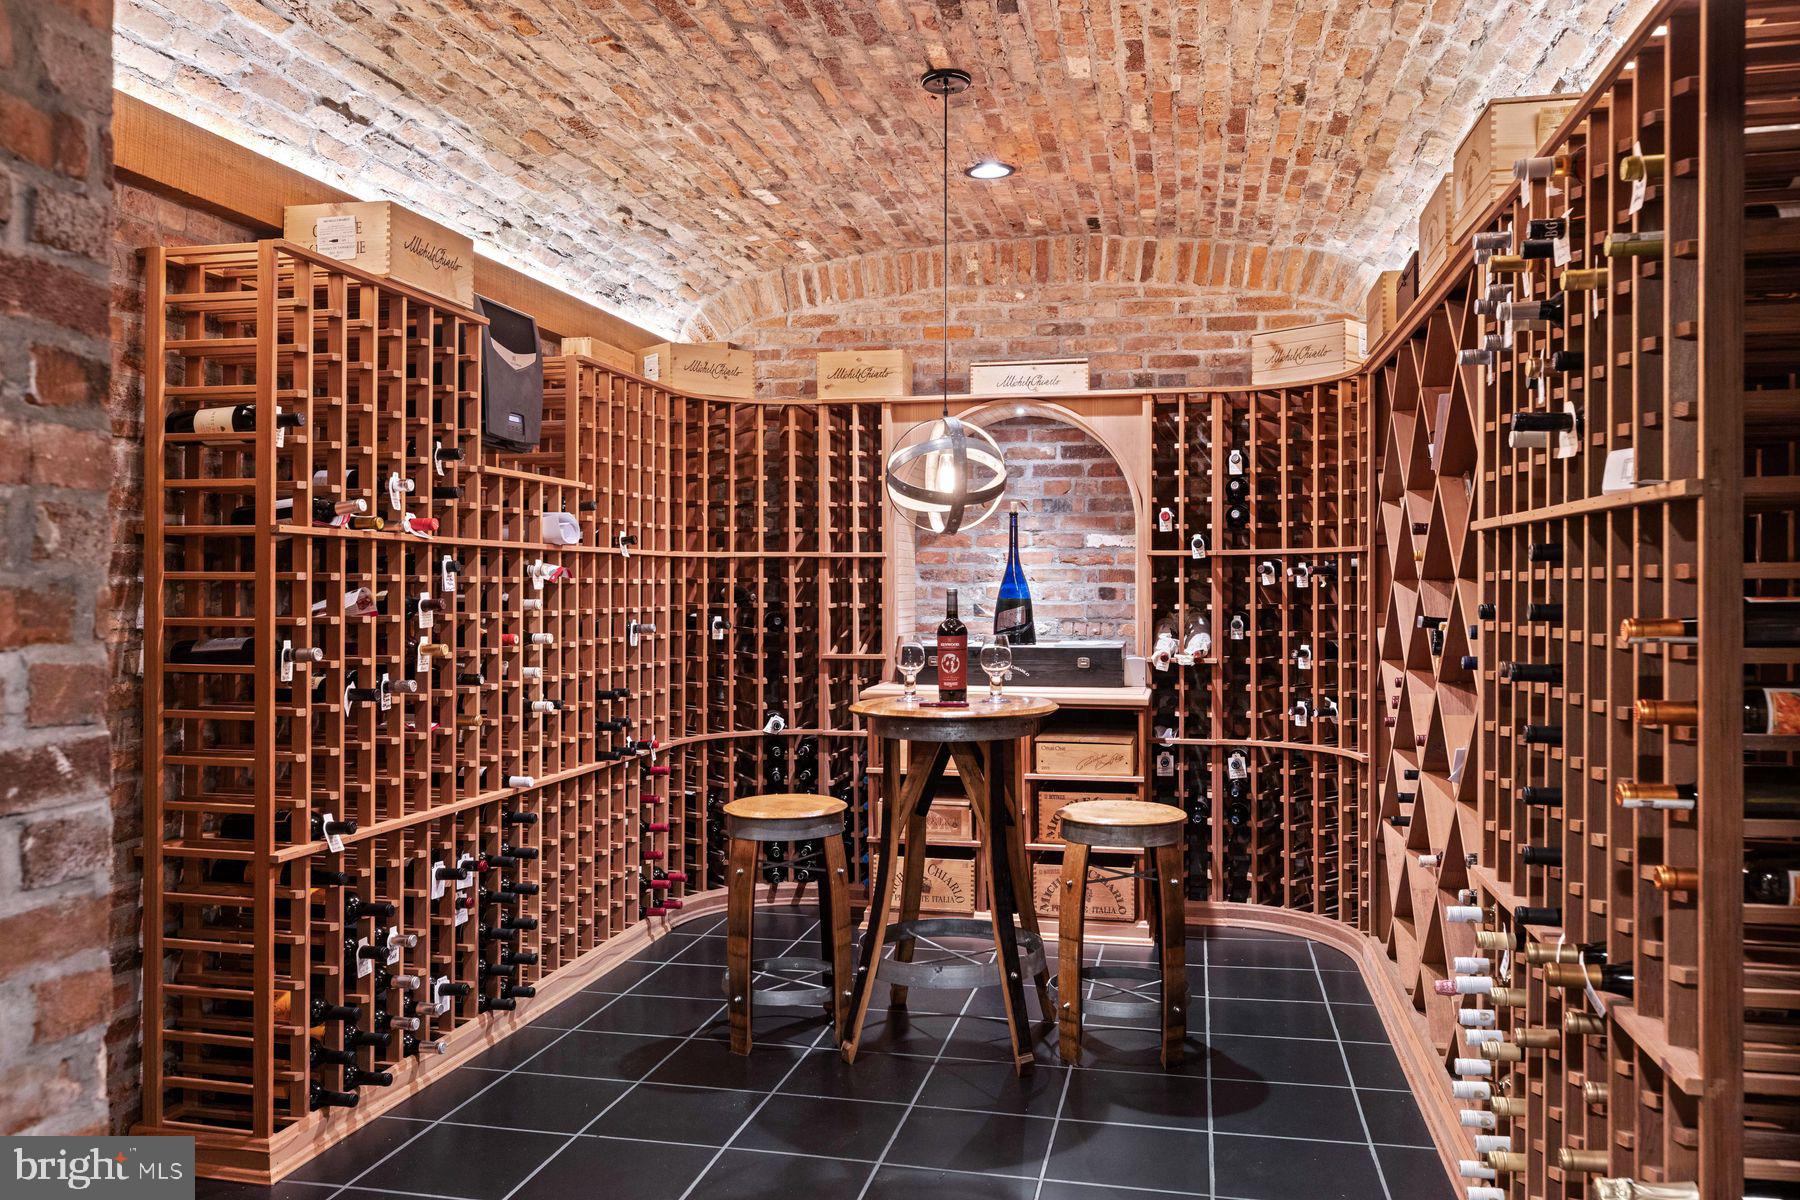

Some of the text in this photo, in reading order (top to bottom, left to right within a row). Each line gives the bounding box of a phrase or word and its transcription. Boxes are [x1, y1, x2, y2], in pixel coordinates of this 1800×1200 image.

[927, 863, 965, 903] CHIARLO
[931, 895, 955, 903] ITALIA
[1092, 906, 1116, 914] ITALIA
